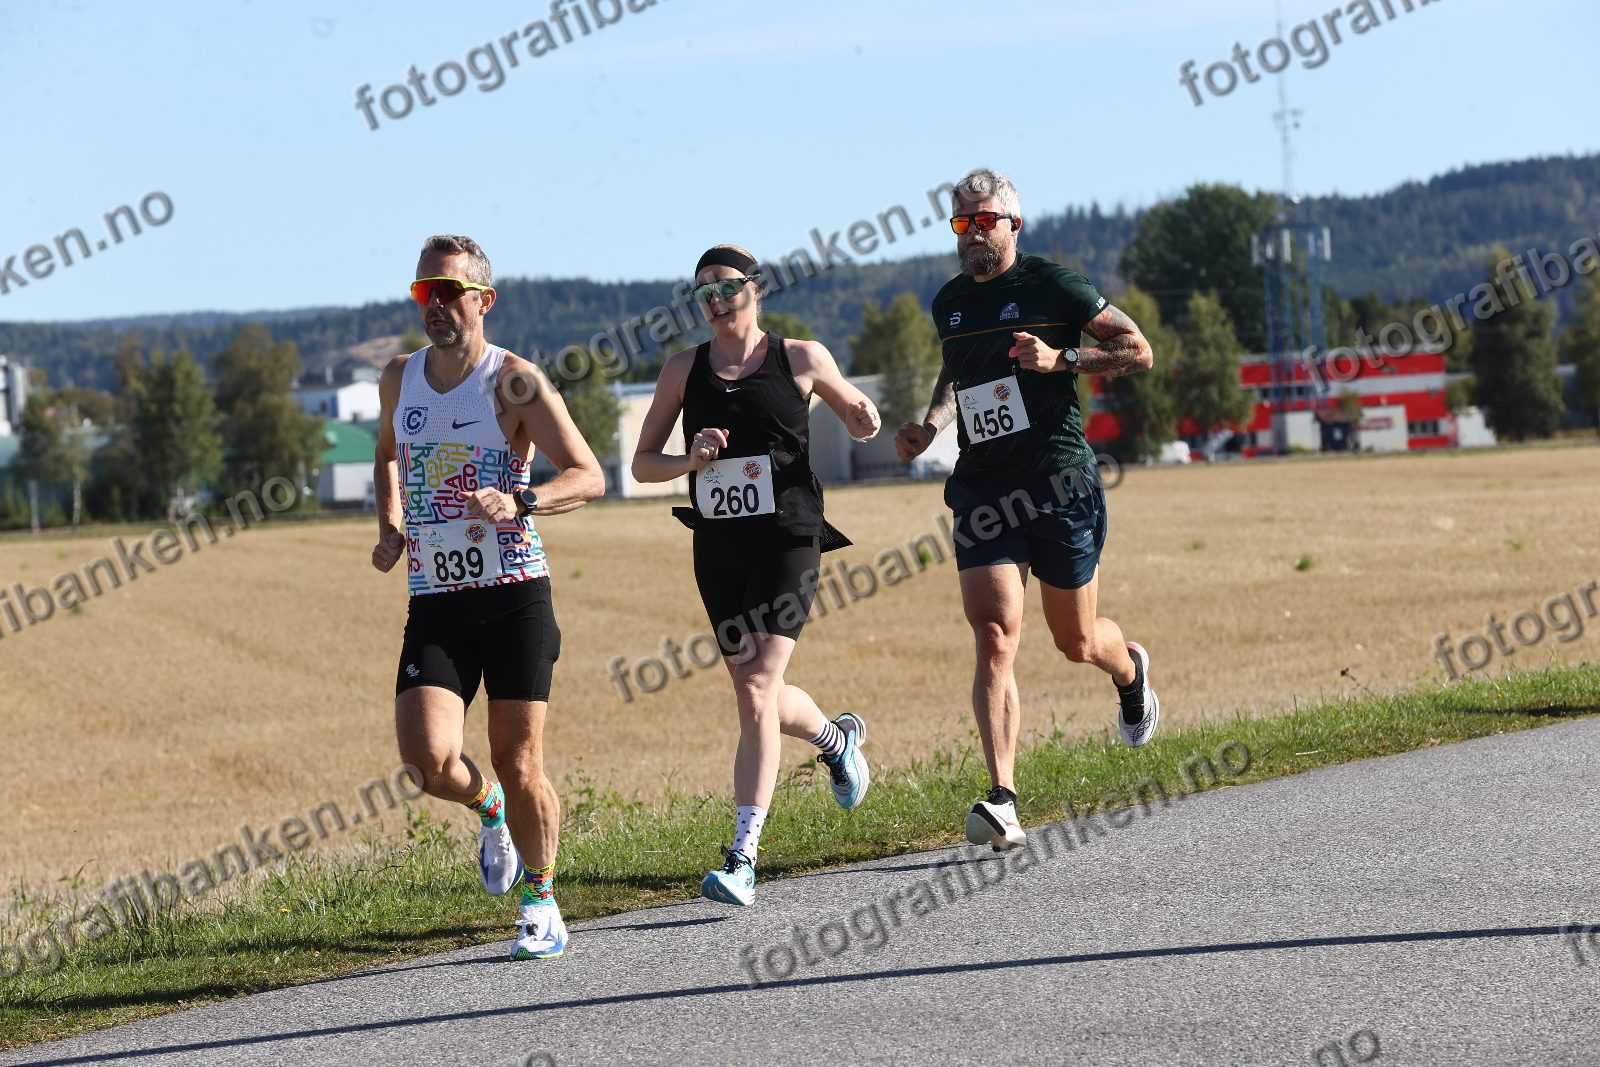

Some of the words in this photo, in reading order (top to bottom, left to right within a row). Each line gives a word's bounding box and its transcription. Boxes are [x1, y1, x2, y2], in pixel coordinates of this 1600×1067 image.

[973, 404, 1014, 438] 456
[710, 483, 760, 516] 260
[434, 546, 484, 583] 839
